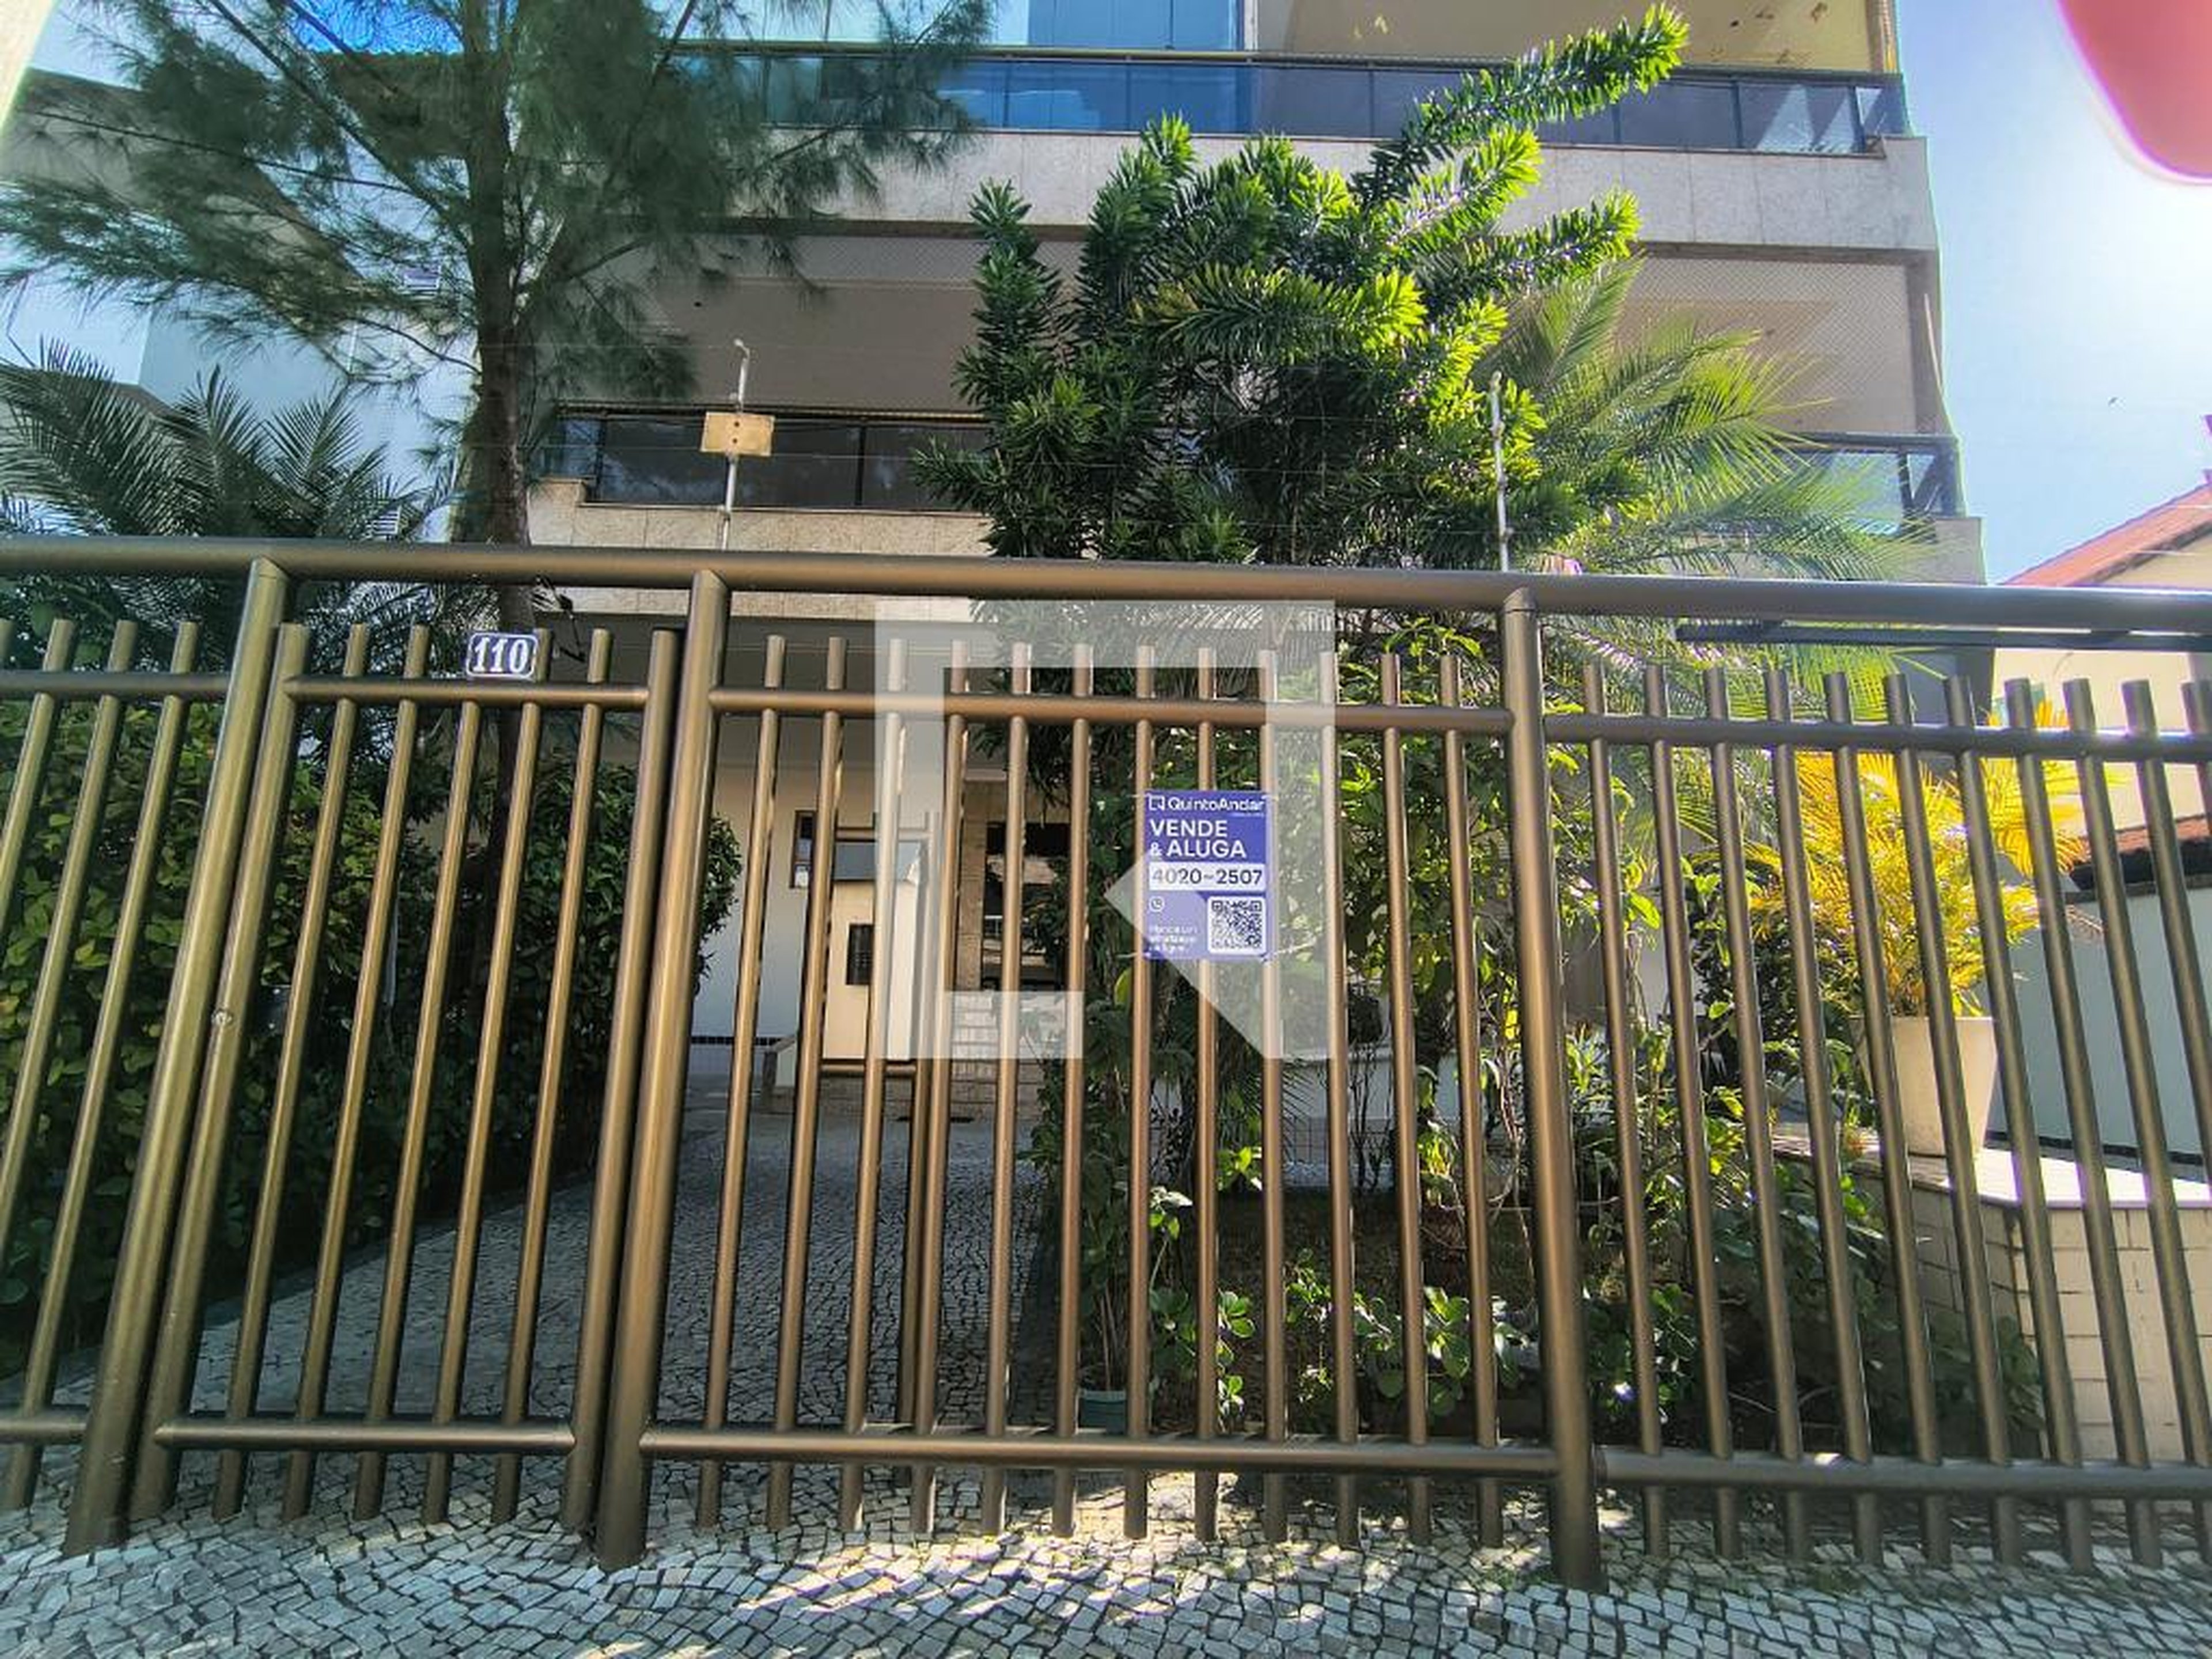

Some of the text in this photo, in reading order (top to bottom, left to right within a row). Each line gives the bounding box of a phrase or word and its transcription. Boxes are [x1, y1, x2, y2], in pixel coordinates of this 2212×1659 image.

[472, 637, 529, 673] 110
[1150, 819, 1228, 837] VENDE
[1150, 839, 1247, 858] & ALUGA
[1152, 868, 1263, 885] 4020-2507
